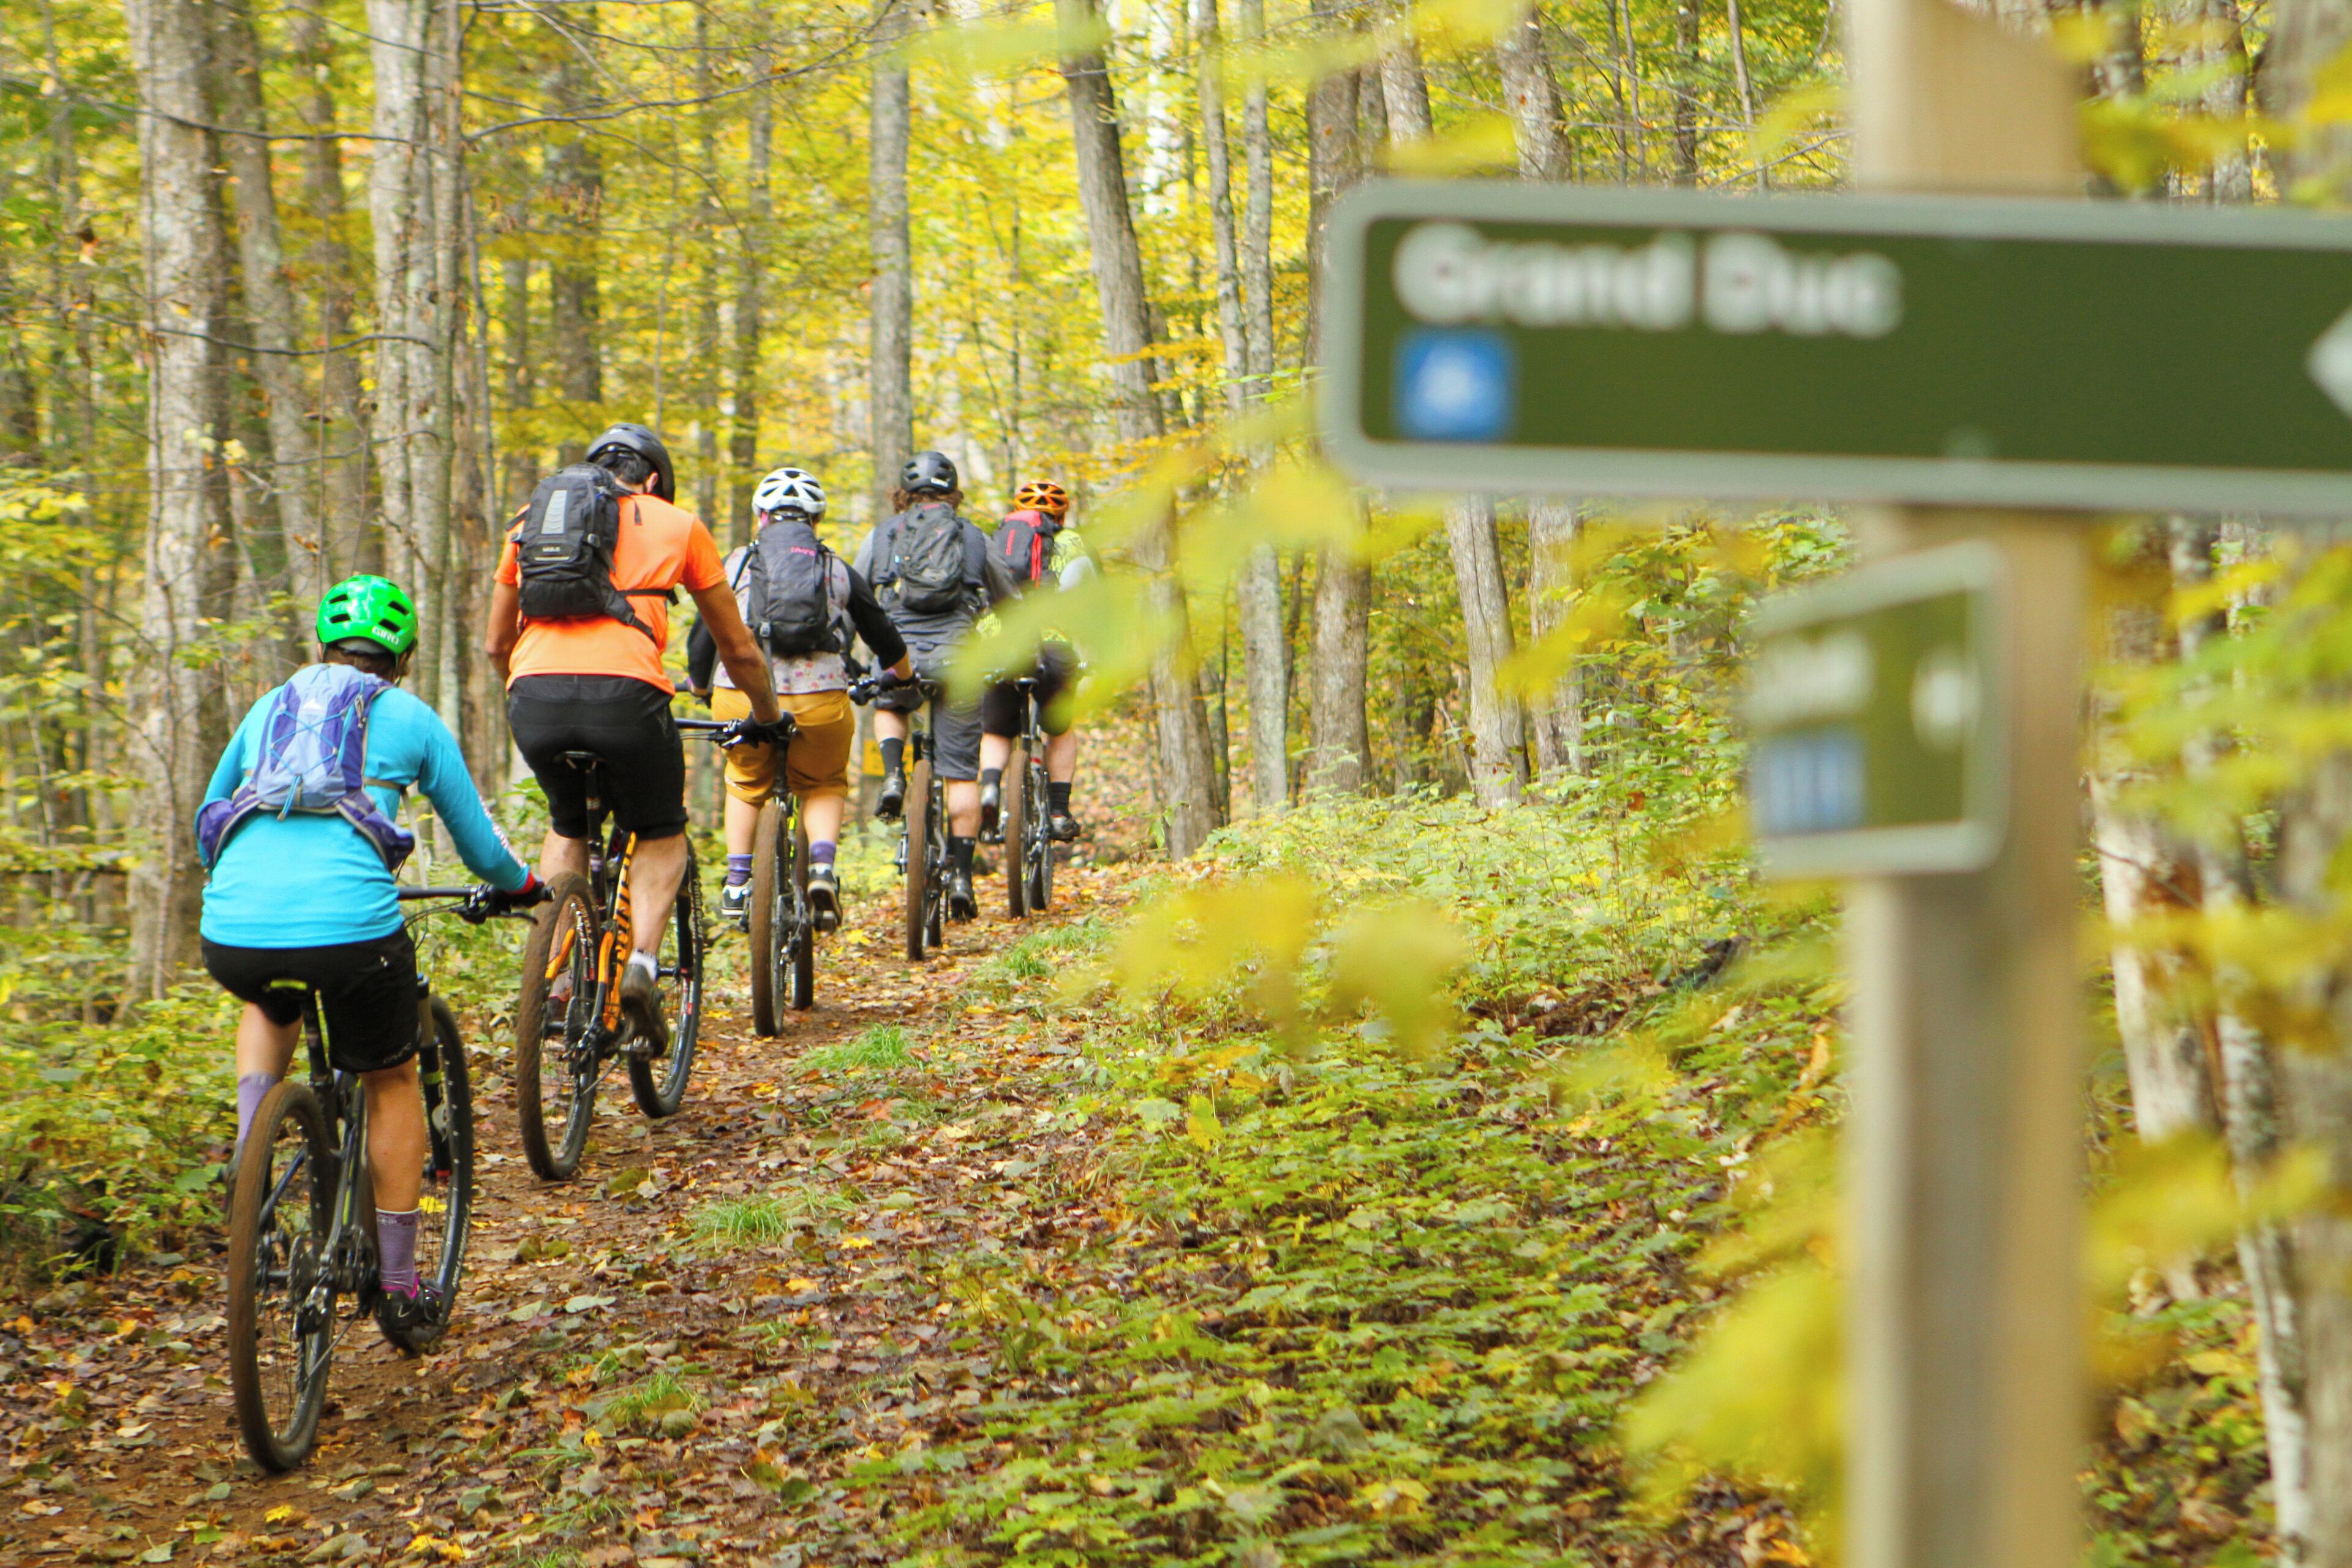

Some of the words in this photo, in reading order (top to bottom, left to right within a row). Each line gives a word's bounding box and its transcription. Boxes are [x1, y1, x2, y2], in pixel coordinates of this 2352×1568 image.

[1393, 223, 1693, 331] Grand
[1706, 230, 1903, 338] Duc
[372, 625, 400, 645] GIRO
